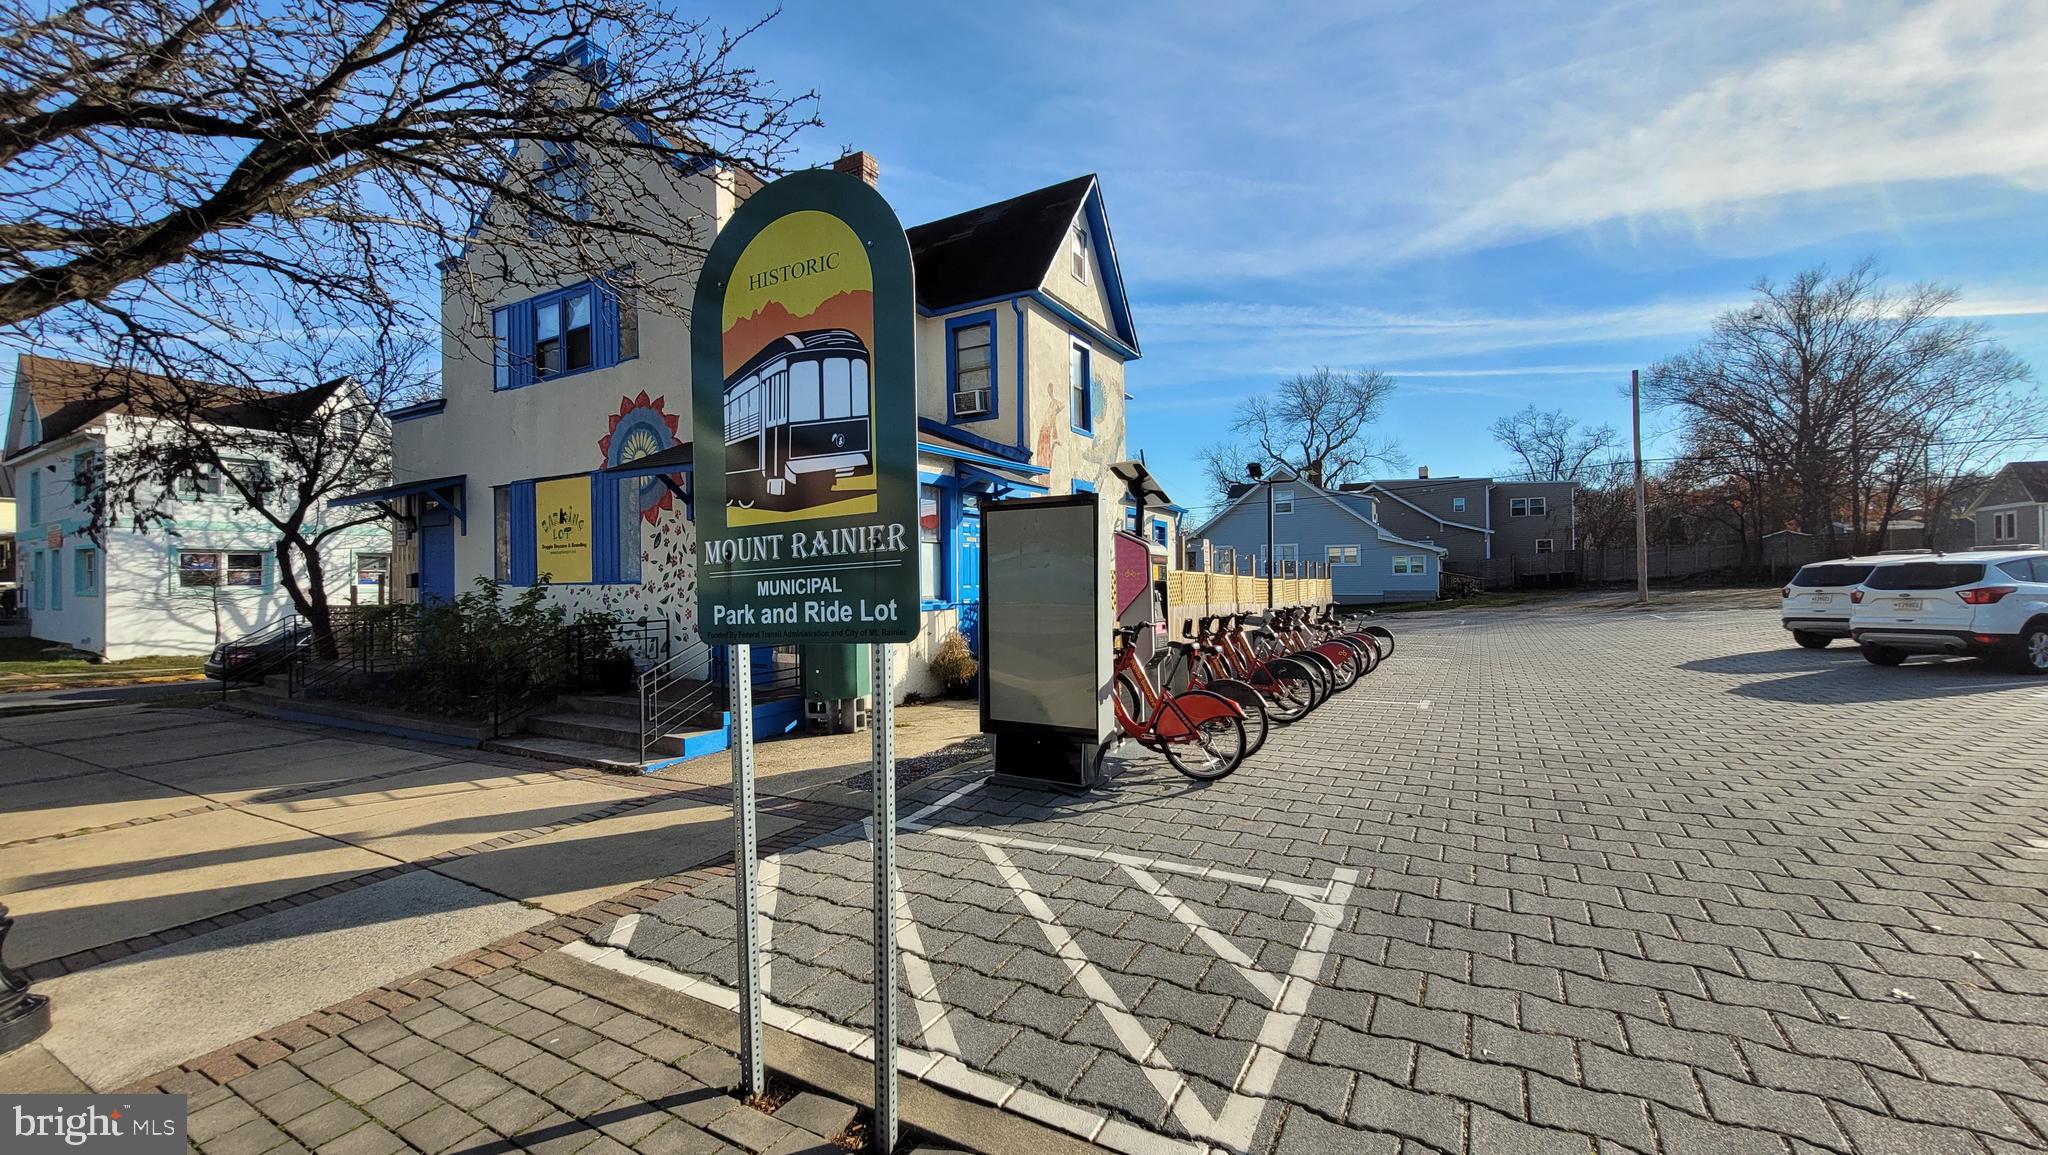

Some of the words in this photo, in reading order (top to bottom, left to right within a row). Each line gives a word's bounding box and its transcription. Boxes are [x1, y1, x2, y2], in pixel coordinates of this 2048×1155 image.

[749, 252, 840, 291] HISTORIC
[703, 533, 784, 566] MOUNT
[791, 523, 909, 560] RAINIER
[757, 576, 842, 597] MUNICIPAL
[713, 603, 756, 625] Park
[760, 602, 798, 624] and
[804, 600, 853, 623] Ride
[860, 599, 898, 621] Lot
[783, 629, 830, 637] Administration
[831, 628, 843, 636] and
[844, 628, 859, 638] City
[859, 628, 867, 636] of
[881, 628, 907, 636] Rainier
